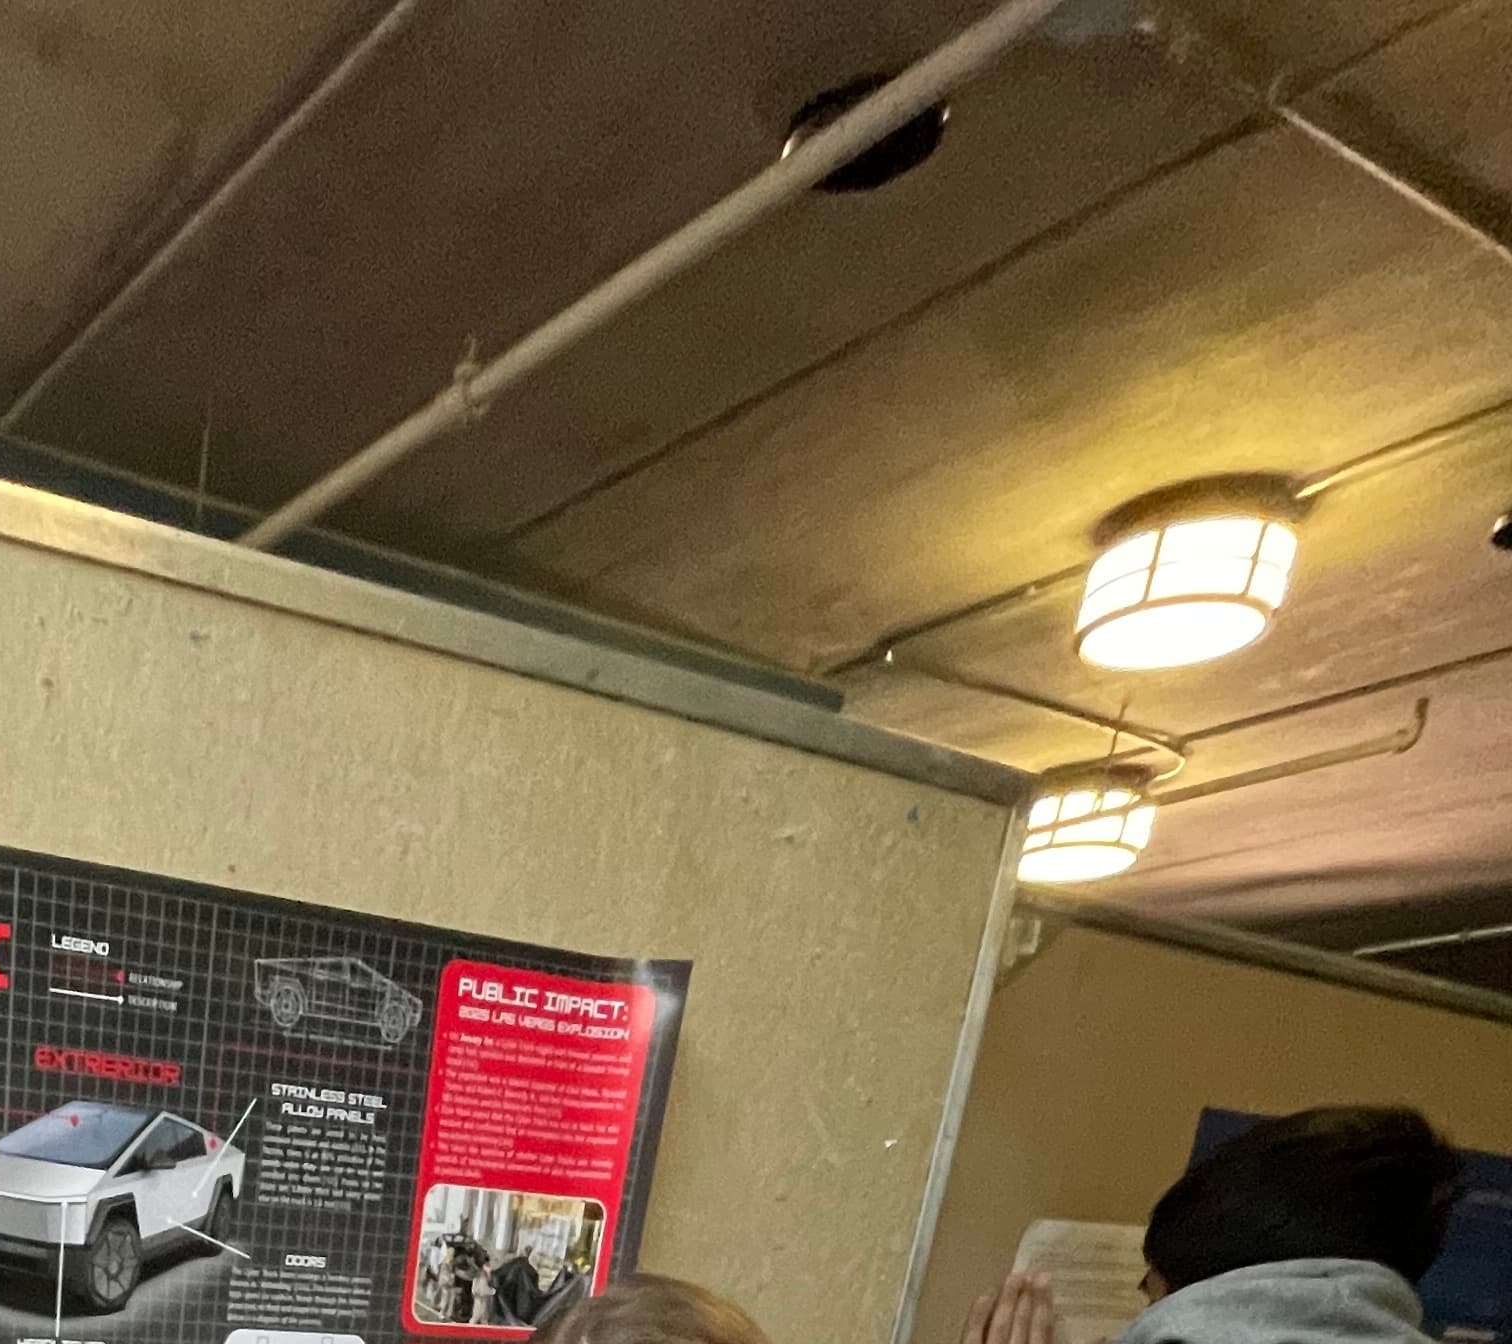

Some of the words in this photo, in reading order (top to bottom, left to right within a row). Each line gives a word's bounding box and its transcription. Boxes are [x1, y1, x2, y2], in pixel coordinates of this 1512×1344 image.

[51, 934, 110, 957] LEGEND
[457, 977, 538, 1009] PUBLIC
[543, 991, 629, 1021] IMPACT:
[492, 1009, 516, 1026] LAS
[557, 1018, 631, 1041] EXPLOSION
[271, 1082, 345, 1103] STAINLESS
[348, 1092, 387, 1108] STEEL
[282, 1102, 324, 1118] ALLOY
[326, 1107, 375, 1124] PANELS
